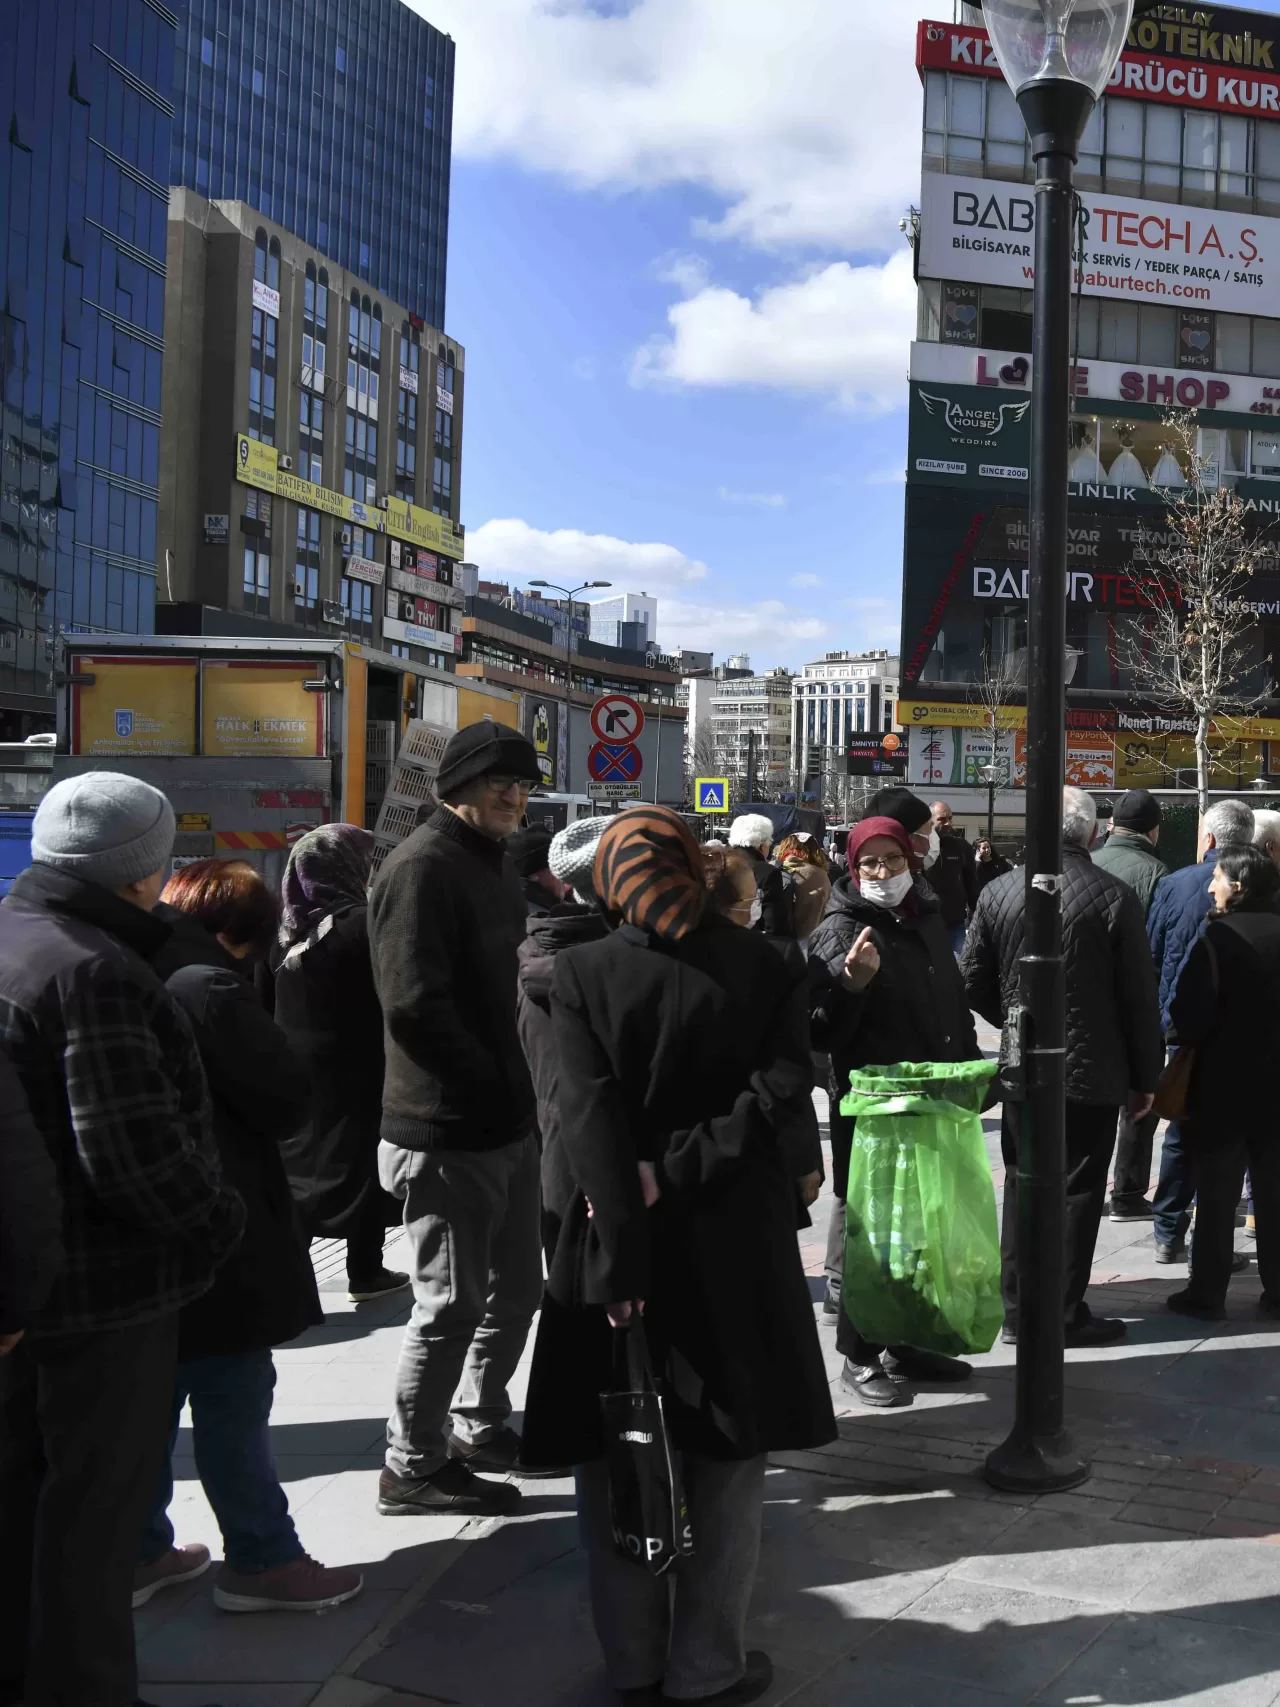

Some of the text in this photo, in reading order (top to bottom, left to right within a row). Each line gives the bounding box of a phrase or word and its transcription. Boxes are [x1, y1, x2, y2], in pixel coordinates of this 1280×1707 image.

[1199, 224, 1264, 268] A.Ş.
[952, 237, 1031, 257] BİLGİSAYAR
[1092, 253, 1131, 269] SERVİS
[1144, 259, 1180, 275] YEDEK
[1183, 266, 1220, 281] PARÇA
[1234, 272, 1264, 287] SATIŞ
[1023, 266, 1211, 300] wbaburtech.com
[945, 328, 976, 341] SHOP
[1181, 355, 1210, 366] SHOP
[1120, 371, 1230, 408] SHOP
[950, 404, 999, 420] ANGEL
[954, 418, 995, 429] HOUSE
[242, 442, 247, 457] 5
[951, 437, 997, 447] WEDDING
[981, 467, 1027, 478] SINCE 2006
[417, 611, 434, 627] THY
[216, 721, 307, 731] HALK EKMEK
[1119, 714, 1152, 732] Money
